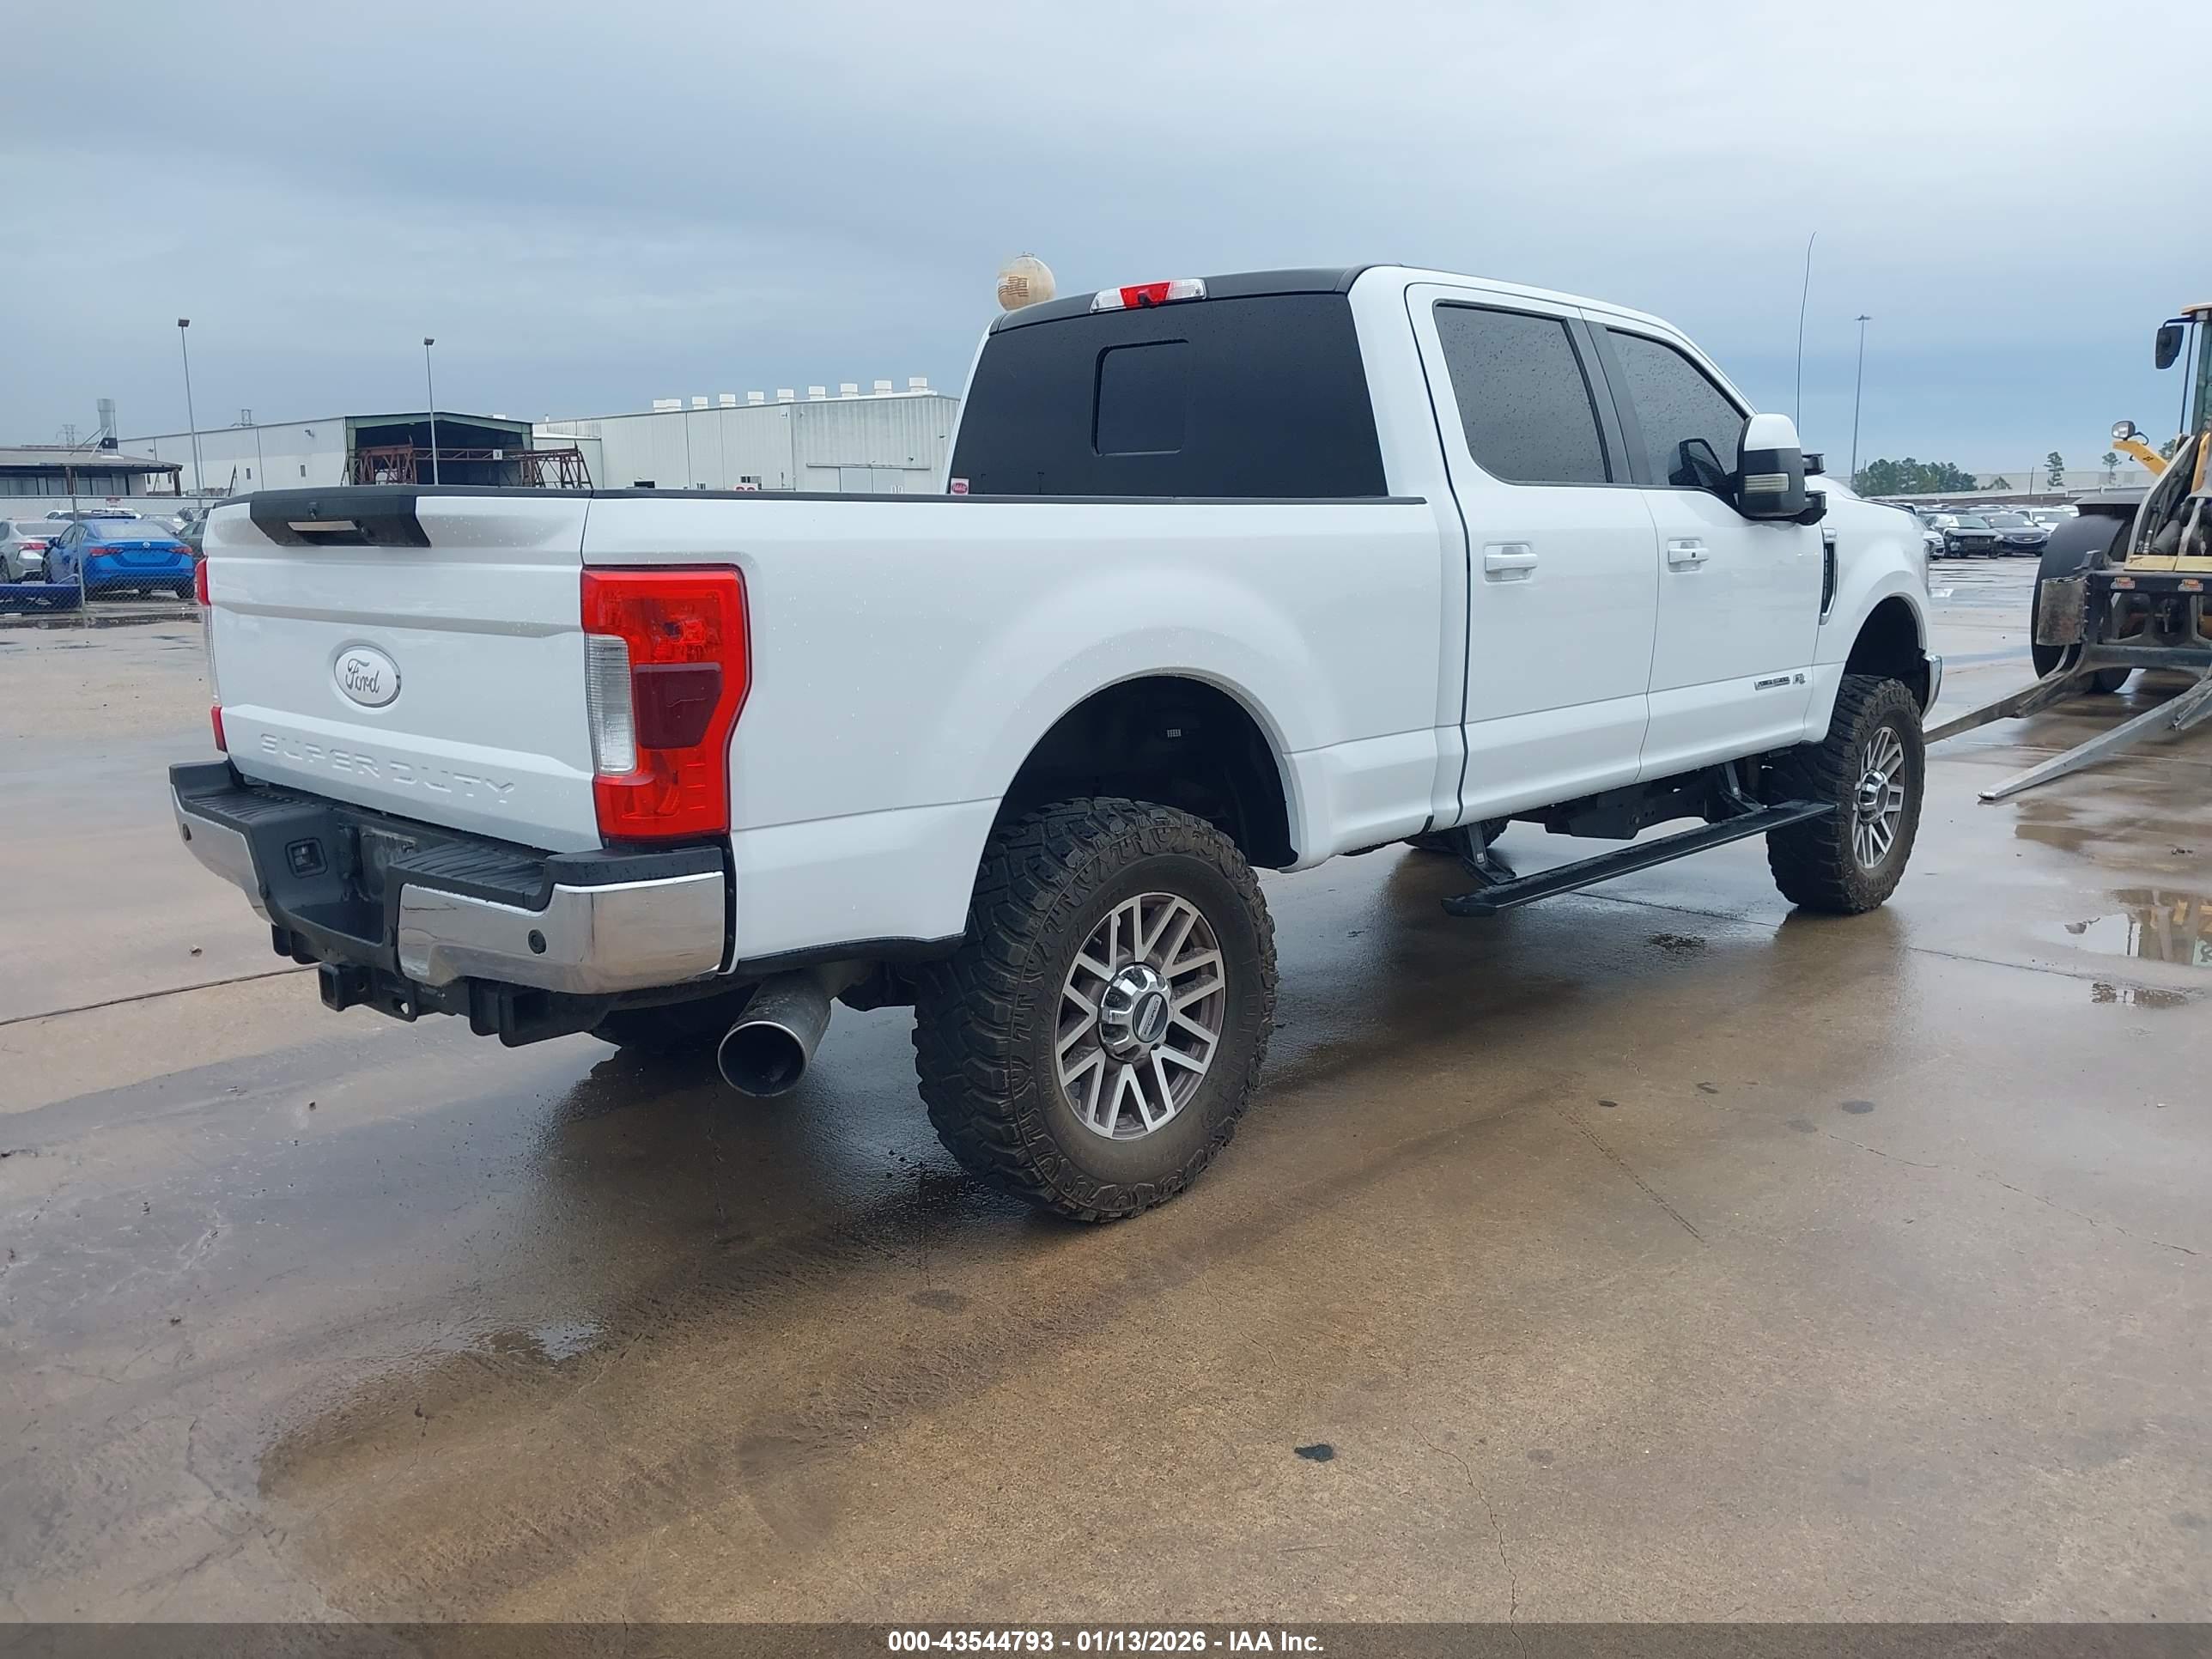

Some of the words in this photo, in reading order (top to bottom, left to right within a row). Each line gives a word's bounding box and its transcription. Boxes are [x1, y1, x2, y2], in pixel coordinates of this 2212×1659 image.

[345, 658, 380, 694] Ford
[259, 732, 380, 778] SUPER
[389, 760, 514, 804] DUTY
